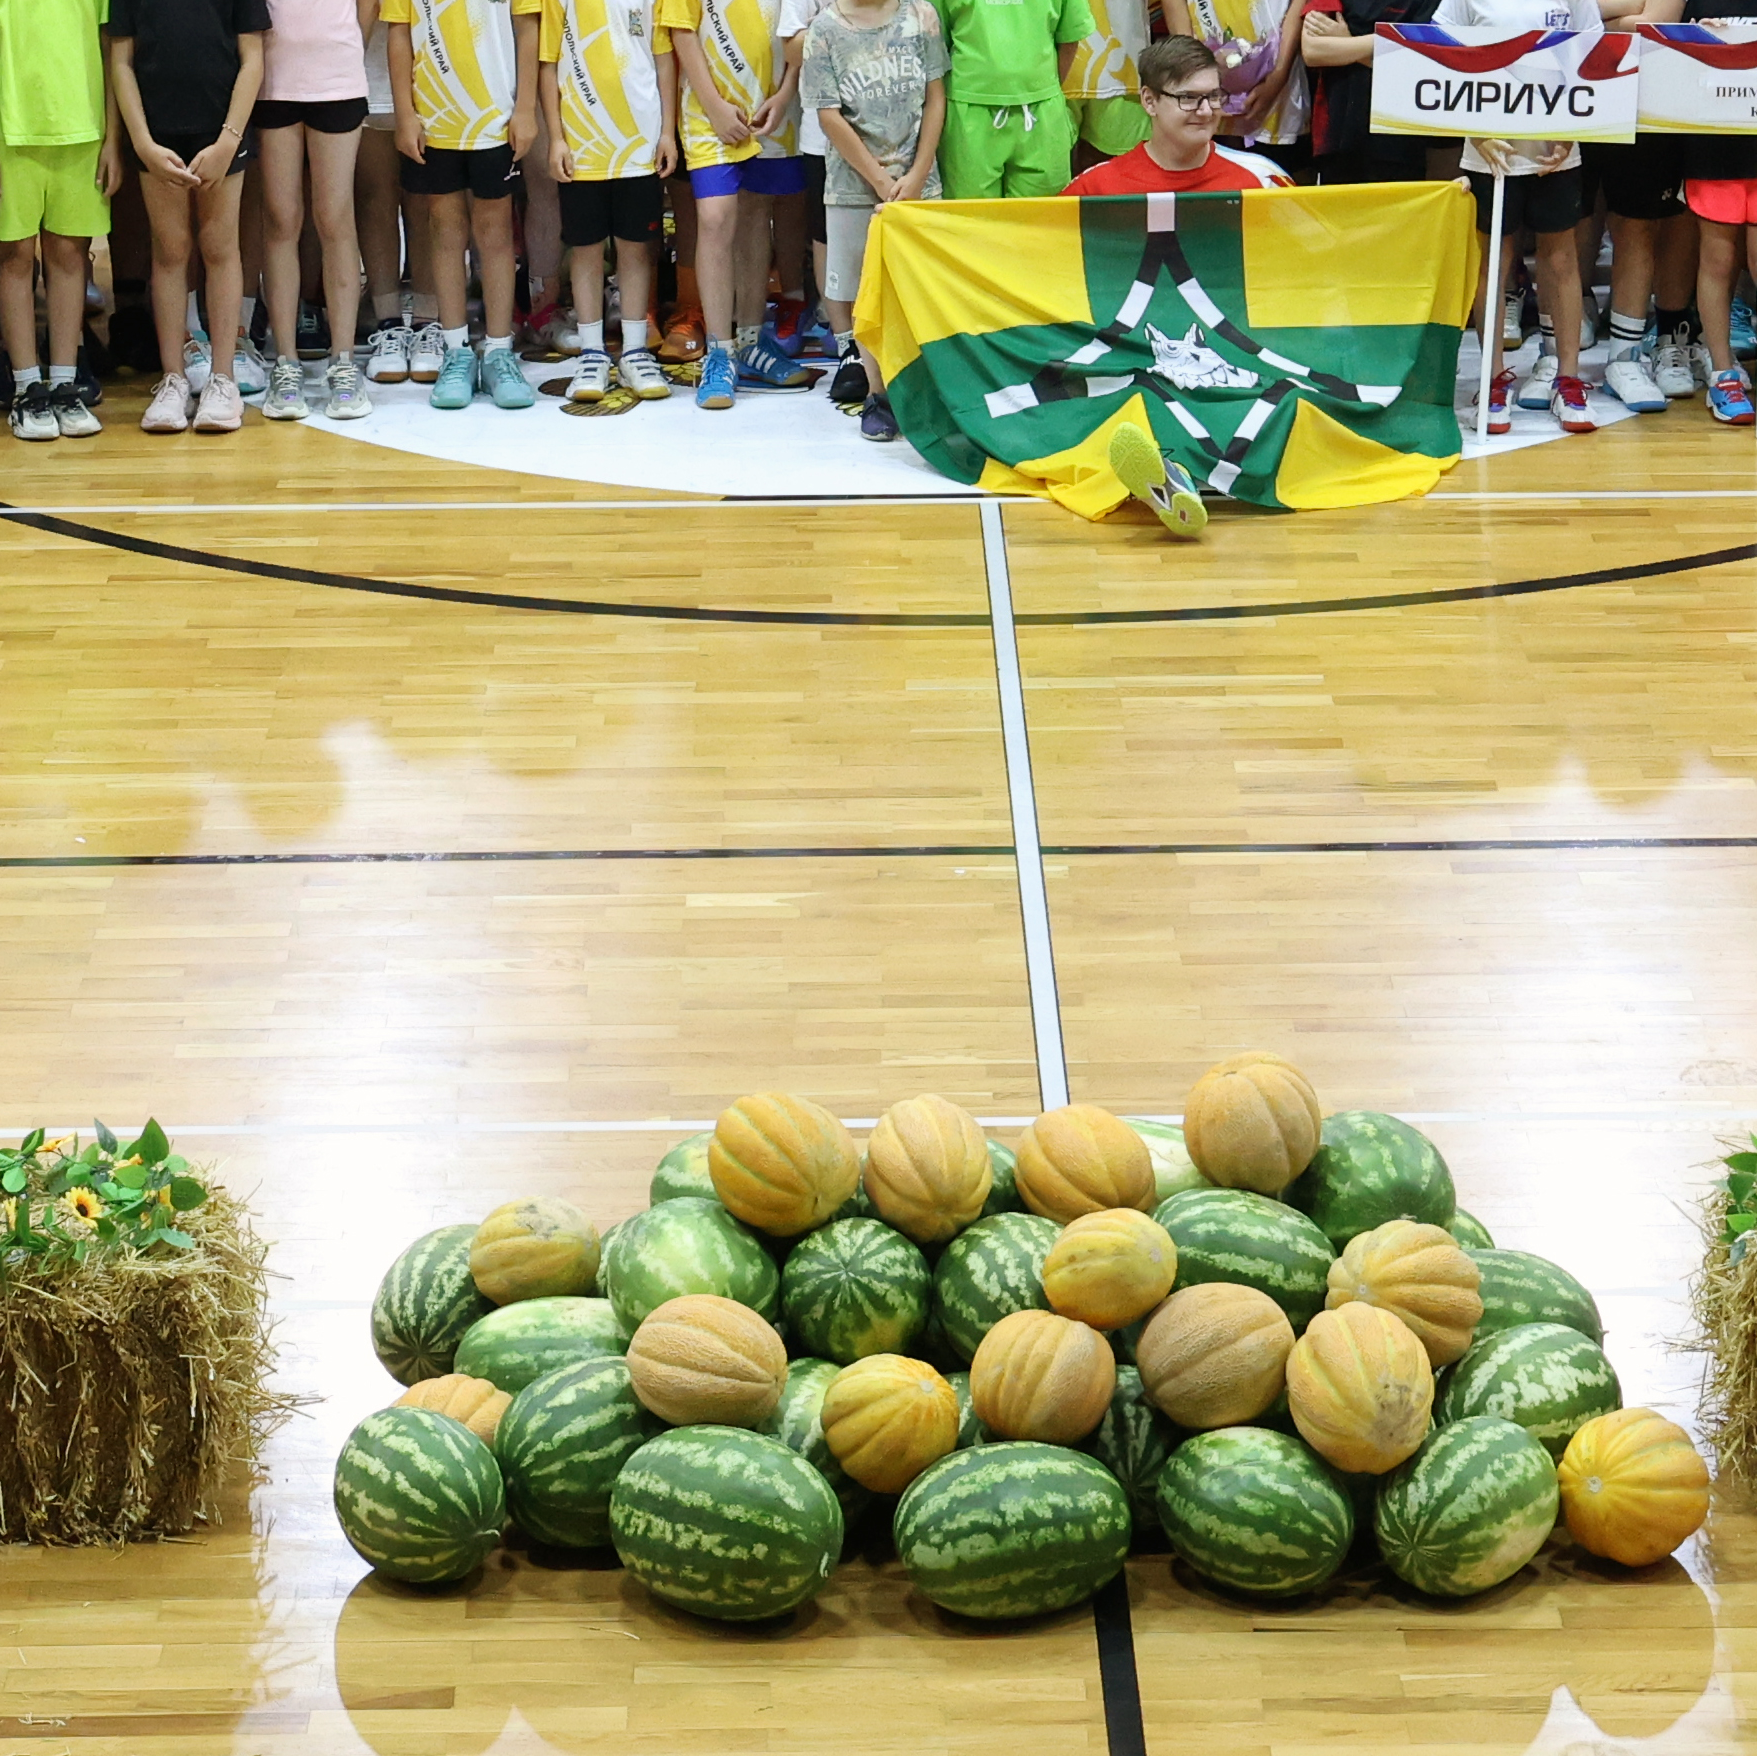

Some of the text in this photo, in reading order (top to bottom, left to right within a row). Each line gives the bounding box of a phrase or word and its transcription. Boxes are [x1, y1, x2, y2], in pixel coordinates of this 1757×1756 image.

[430, 47, 449, 75] КРАЙ
[722, 44, 745, 74] КРАЙ
[579, 80, 597, 107] КРАЙ
[838, 54, 926, 103] WILDNES
[1414, 78, 1596, 118] СИРИУС
